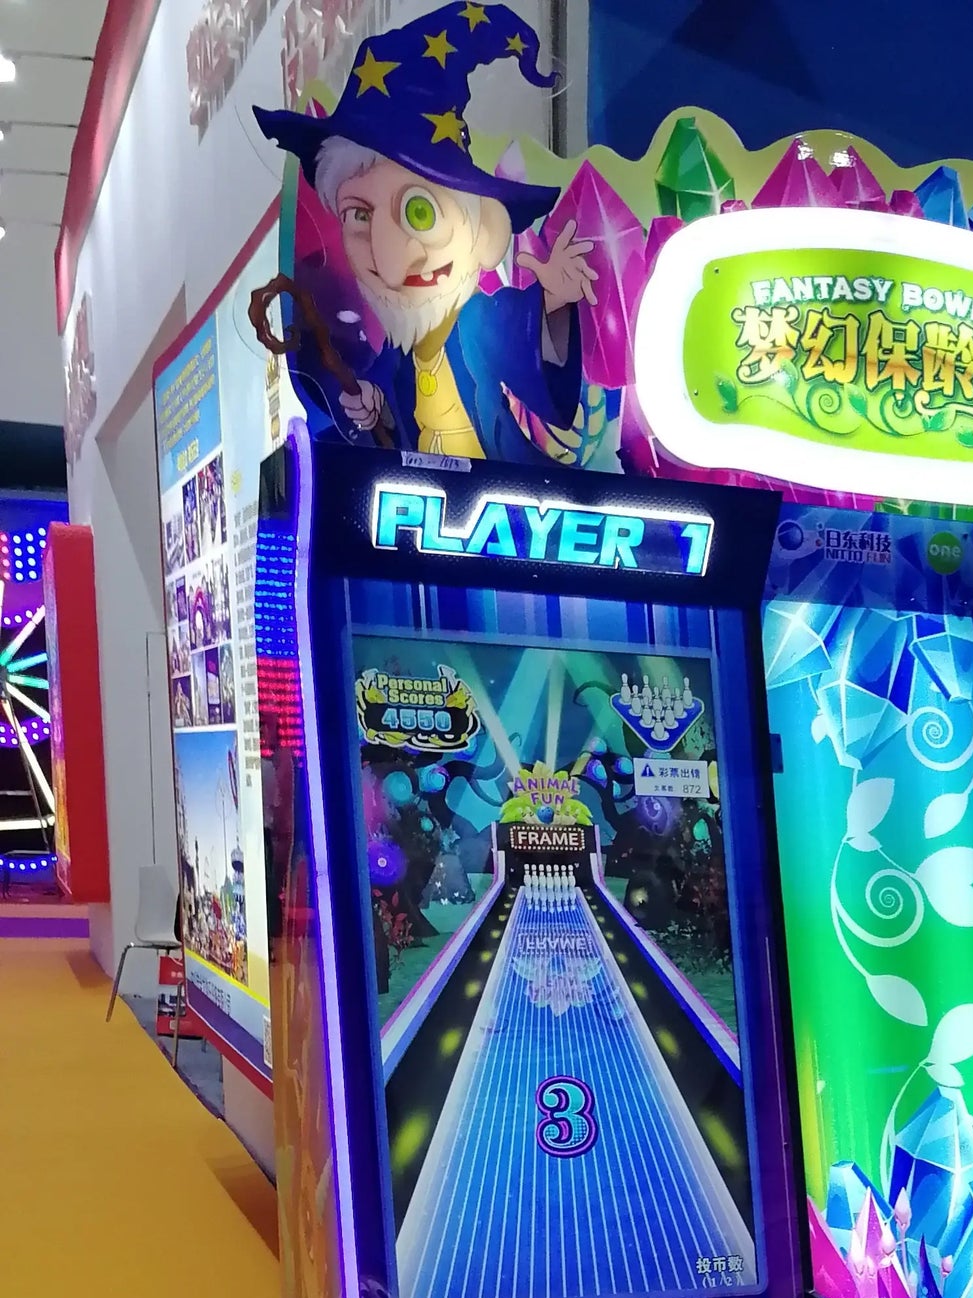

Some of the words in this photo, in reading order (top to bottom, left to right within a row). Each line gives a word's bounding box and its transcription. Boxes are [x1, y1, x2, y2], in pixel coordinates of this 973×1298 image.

[750, 276, 895, 305] FANTASY
[377, 489, 645, 569] PLAYER
[680, 522, 712, 574] 1
[825, 529, 892, 553] 日东科技
[929, 543, 962, 558] one
[376, 673, 449, 693] Personal
[388, 689, 445, 706] Scores
[381, 707, 452, 732] 4550
[513, 776, 580, 794] ANIMAL
[682, 784, 702, 794] 872
[530, 791, 565, 806] FUN
[517, 831, 579, 847] FRAME
[537, 1077, 596, 1156] 3
[695, 1256, 743, 1273] 投币数
